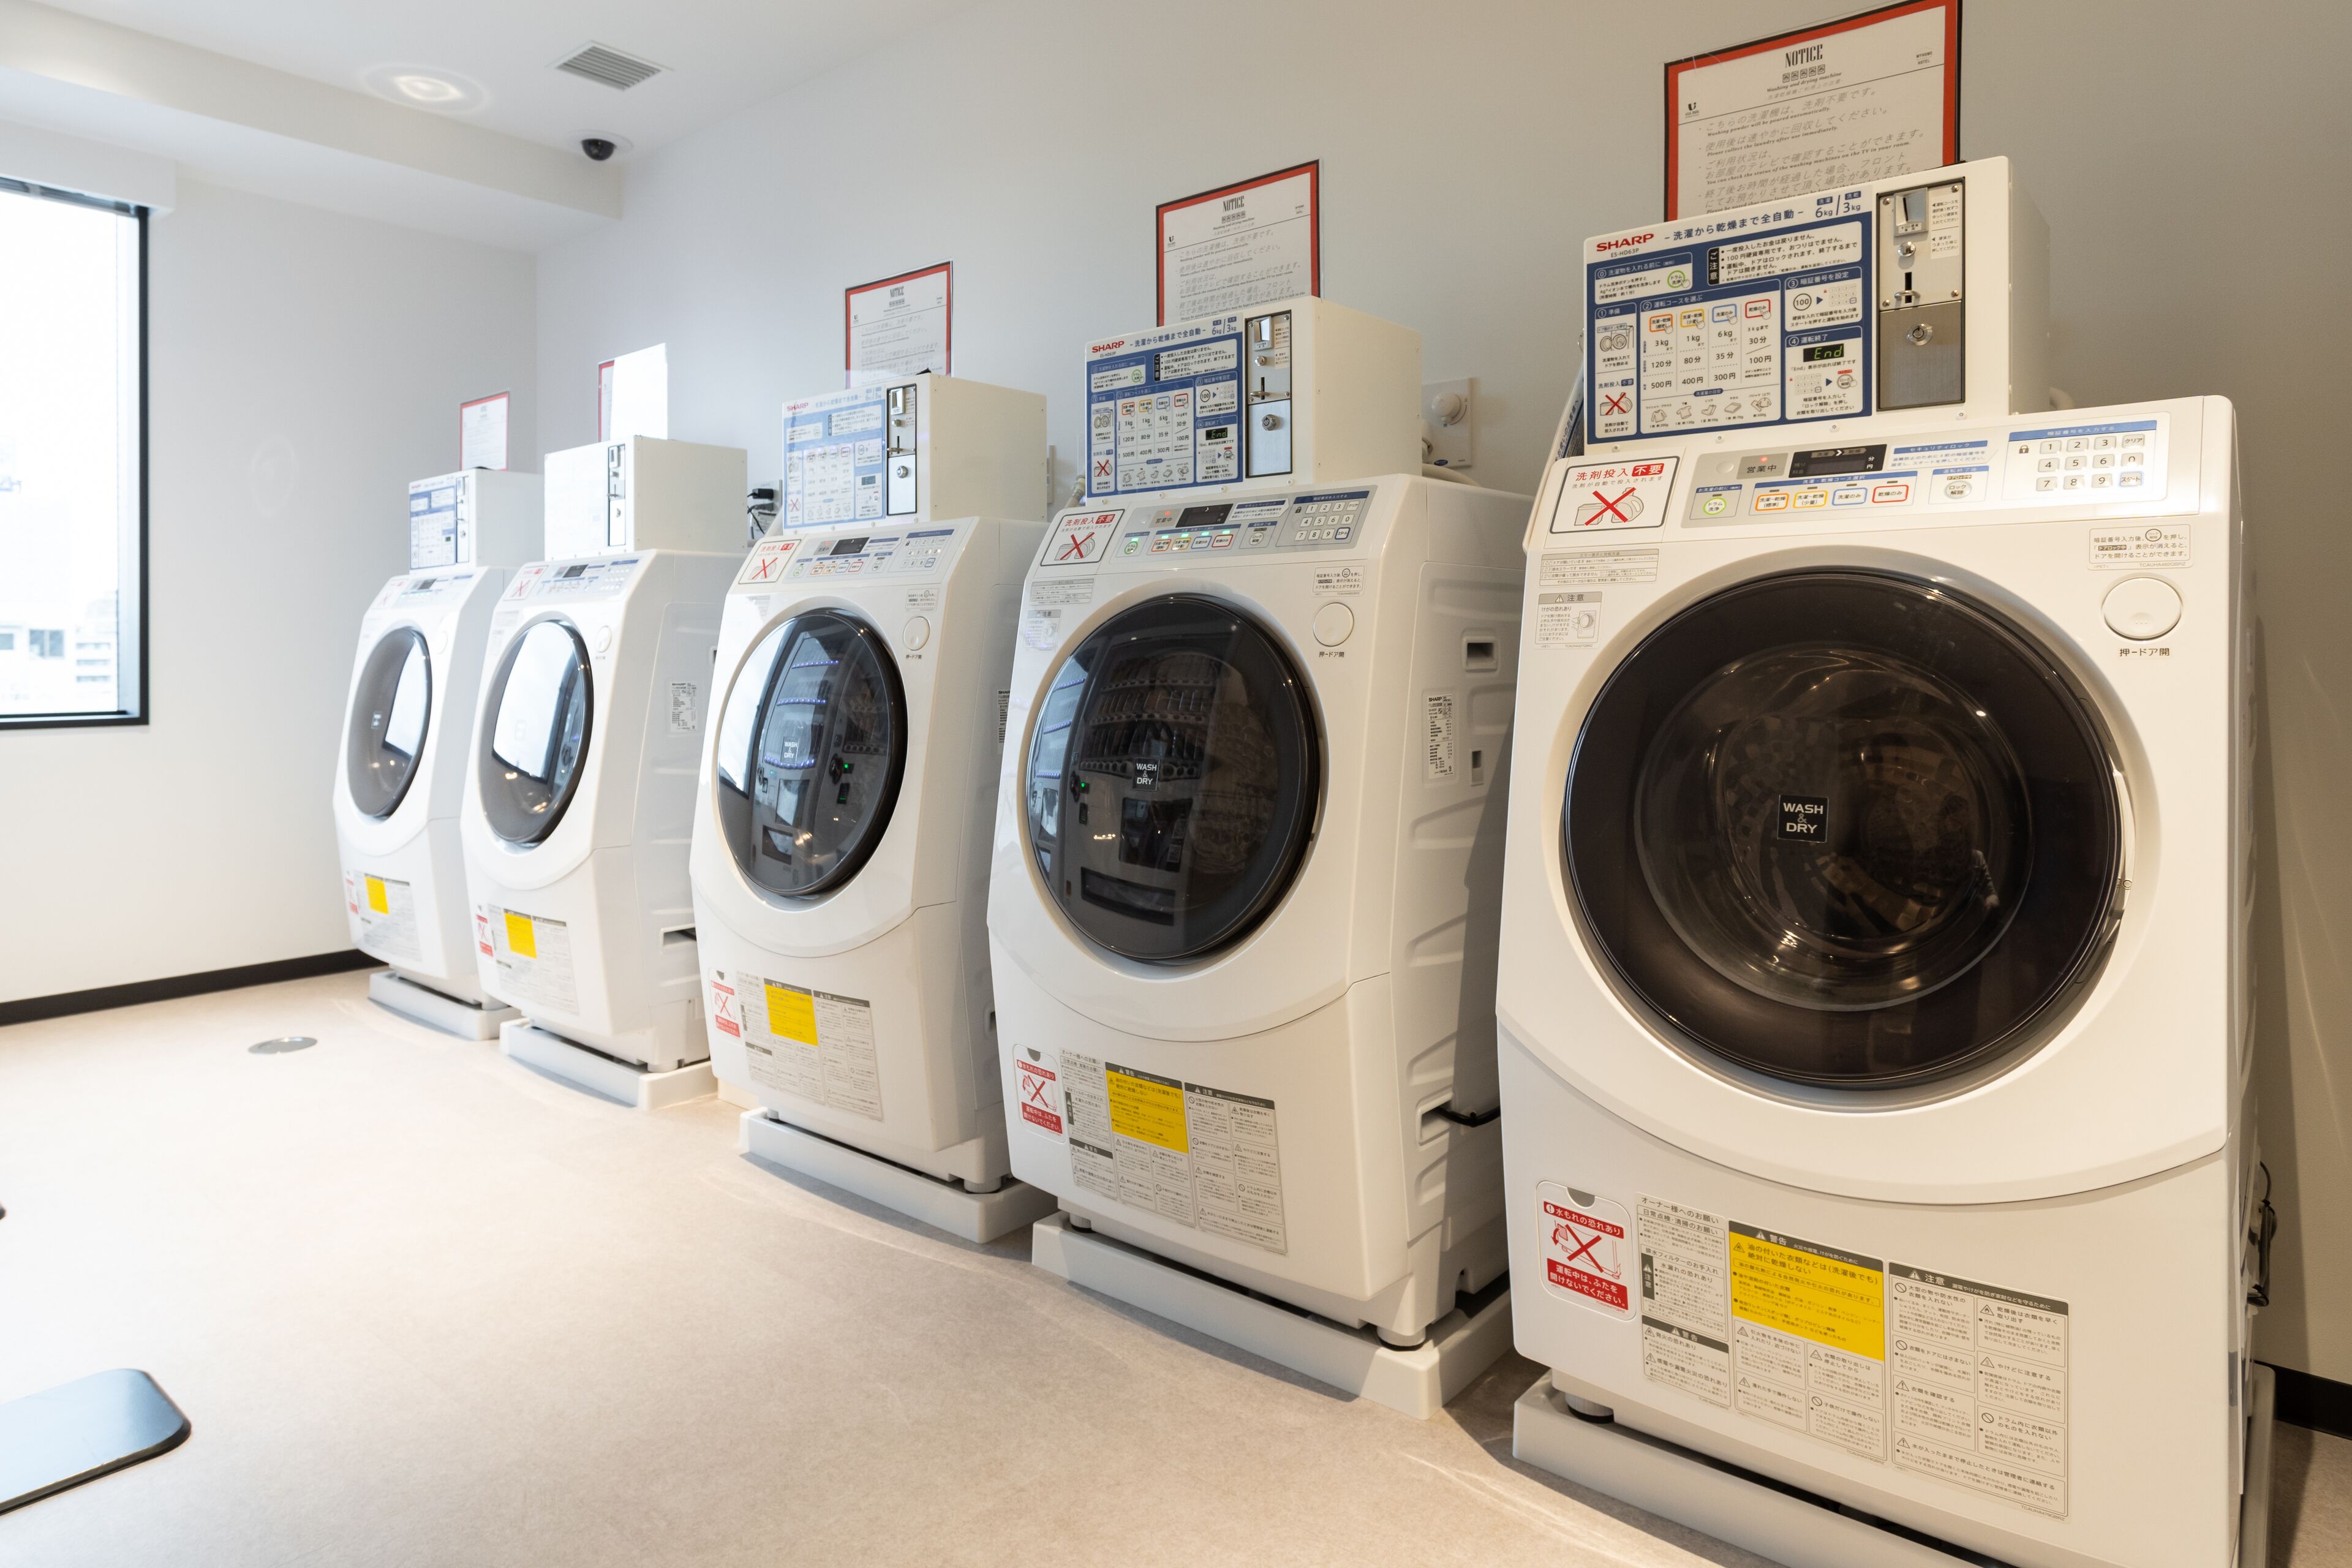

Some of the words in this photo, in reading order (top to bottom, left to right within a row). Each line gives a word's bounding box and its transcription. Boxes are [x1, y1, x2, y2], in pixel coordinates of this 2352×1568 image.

[1785, 44, 1823, 68] NOTICE
[1766, 83, 1789, 93] Washing
[1800, 77, 1819, 85] drying
[1819, 71, 1842, 81] machine
[1770, 115, 1790, 125] poured
[1790, 107, 1831, 120] automatically.
[1802, 126, 1838, 137] immediately.
[1706, 150, 1771, 170] ご利用状況は、
[1223, 195, 1245, 213] NOTICE
[1843, 202, 1861, 213] 3kg
[1815, 207, 1833, 218] 6kg
[1596, 233, 1654, 252] SHARP
[1610, 247, 1640, 258] ES-HD63P
[1727, 263, 1778, 276] ドアは開きません。
[1800, 272, 1849, 285] 暗証番号を設定
[1654, 295, 1703, 308] 運転コースを選ぶ
[1801, 334, 1828, 344] 運転終了
[1092, 341, 1125, 353] SHARP
[1814, 345, 1843, 360] End
[786, 402, 809, 412] SHARP
[1212, 430, 1227, 439] End
[1910, 443, 1970, 453] セキュリティロック
[1575, 468, 1628, 481] 洗剤投入
[1634, 464, 1664, 475] 不要
[1746, 464, 1777, 473] 営業中
[1572, 476, 1664, 489] 洗剤が自動で投入されます
[1065, 517, 1095, 527] 洗剤投入
[1783, 802, 1823, 814] WASH
[1797, 813, 1807, 823] &
[1786, 823, 1818, 833] DRY
[1642, 1197, 1719, 1224] オーナー様へのお願い
[1556, 1208, 1621, 1235] 水もれの恐れあり
[1770, 1234, 1787, 1246] 警告
[1646, 1248, 1719, 1275] 排水フィルターのお手入れ
[1747, 1251, 1811, 1275] 絶対に乾燥しない
[1556, 1265, 1618, 1294] 運転中は、ふたを
[1660, 1263, 1713, 1283] 水漏れの恐れあり
[1924, 1273, 1945, 1286] 注意
[1550, 1272, 1626, 1307] 開けないでください。
[1909, 1284, 1966, 1303] 大型の物や防水性の
[1909, 1291, 1953, 1306] 衣類を入れない
[1997, 1306, 2059, 1325] 乾燥後は衣類を早く
[1997, 1313, 2024, 1324] 取り出す
[1683, 1330, 1698, 1341] 警告
[1909, 1345, 1972, 1366] 衣類をドアにはさまない
[1997, 1363, 2051, 1381] やけどに注意する
[1911, 1386, 1955, 1403] 衣類を確認する
[1997, 1422, 2052, 1440] のものを入れない
[1998, 1415, 2059, 1436] ドラム内に衣類以外
